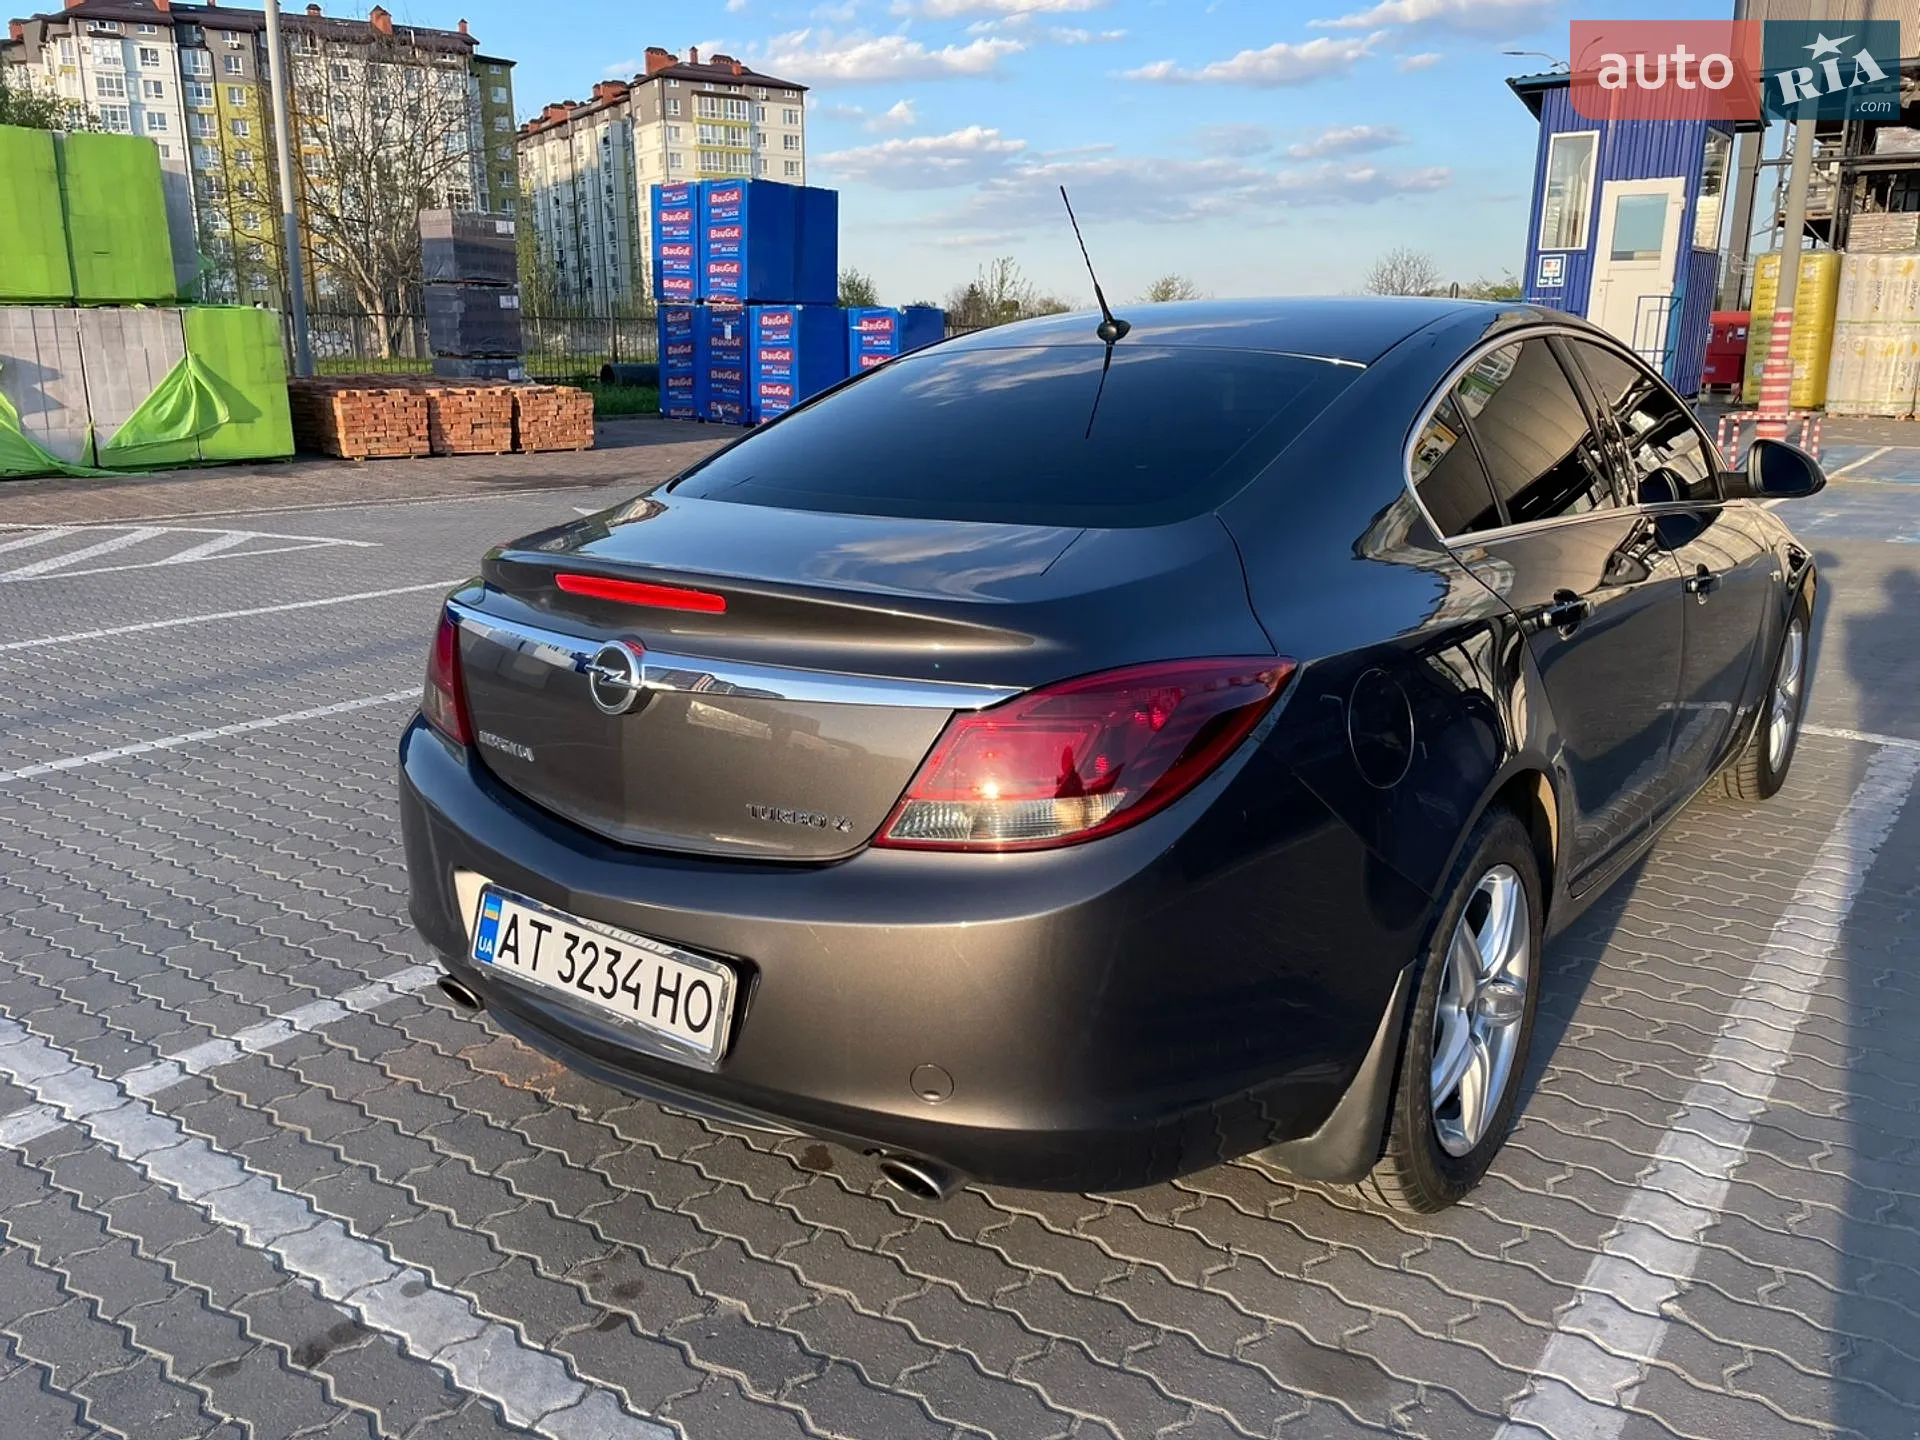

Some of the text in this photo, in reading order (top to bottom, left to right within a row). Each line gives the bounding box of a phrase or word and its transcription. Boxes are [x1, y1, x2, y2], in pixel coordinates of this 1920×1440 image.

[711, 192, 739, 203] BauGut
[661, 212, 689, 221] BauGut
[710, 229, 739, 238] BauGut
[662, 246, 690, 255] BauGut
[709, 264, 737, 273] BauGut
[663, 280, 690, 289] BauGut
[762, 314, 789, 325] BauGut
[761, 350, 790, 360] BauGut
[761, 384, 790, 396] BauGut
[478, 935, 493, 954] UA
[497, 913, 552, 971] AT
[557, 932, 643, 1010] 3234
[652, 965, 713, 1034] HO
